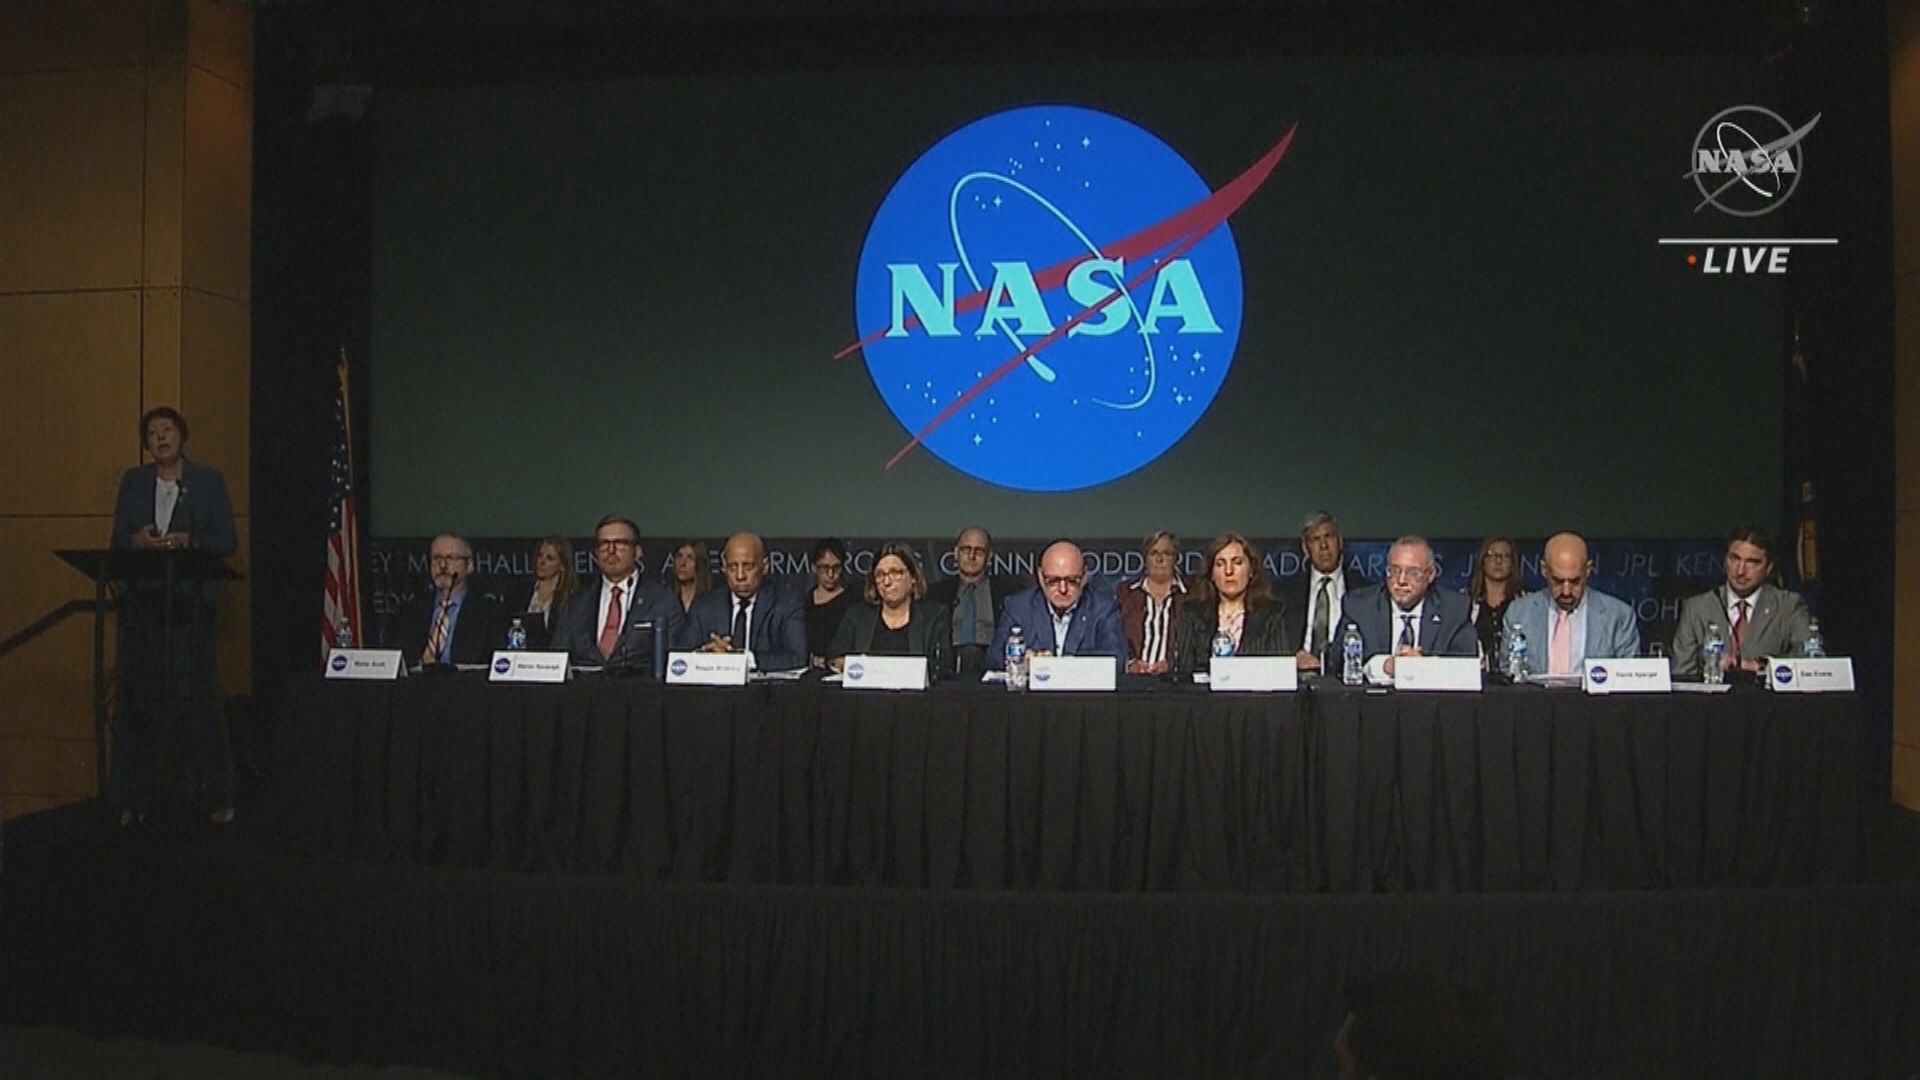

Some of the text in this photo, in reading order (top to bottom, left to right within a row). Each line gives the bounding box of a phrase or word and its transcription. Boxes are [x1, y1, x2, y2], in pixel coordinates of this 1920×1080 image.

[884, 256, 1223, 338] NASA
[408, 551, 534, 575] MHALL
[1617, 552, 1660, 577] JPL
